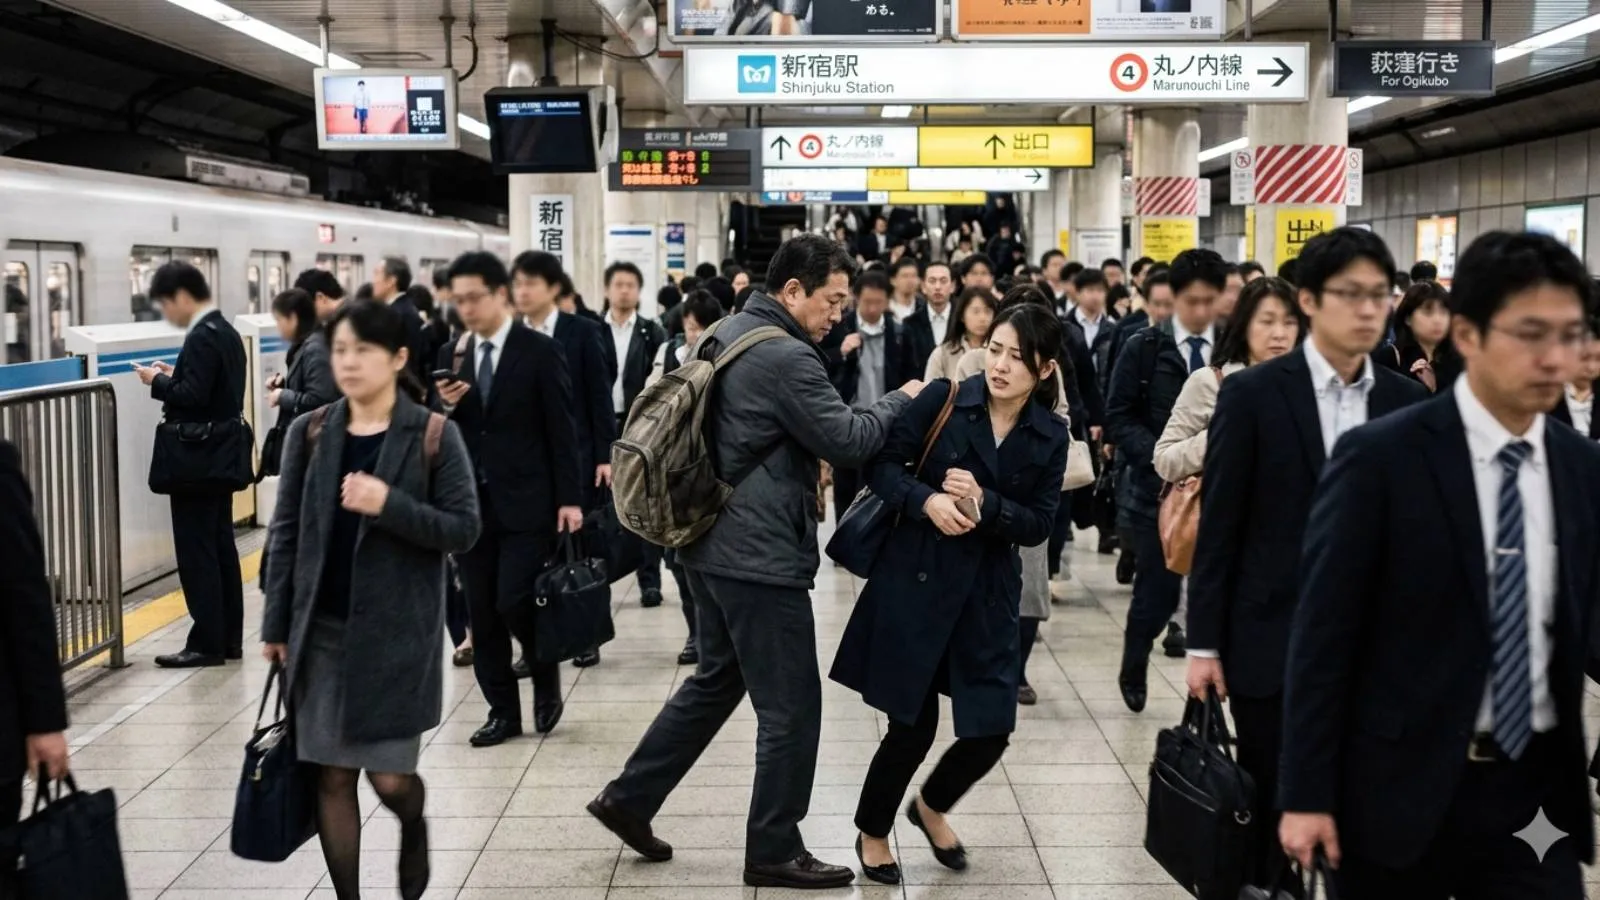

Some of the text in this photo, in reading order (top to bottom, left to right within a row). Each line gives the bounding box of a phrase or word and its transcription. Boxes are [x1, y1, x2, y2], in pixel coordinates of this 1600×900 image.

[781, 54, 859, 78] 新宿駅
[1121, 65, 1136, 80] 4
[1152, 54, 1243, 76] 丸ノ内線
[1371, 52, 1460, 74] 荻窪行き
[782, 81, 894, 96] Shinjuku Station
[1153, 79, 1250, 91] Marunouchi Line
[1381, 76, 1449, 88] For Ogikubo
[1013, 132, 1049, 149] 出口
[539, 200, 564, 266] 新宿
[1286, 219, 1324, 244] 出
